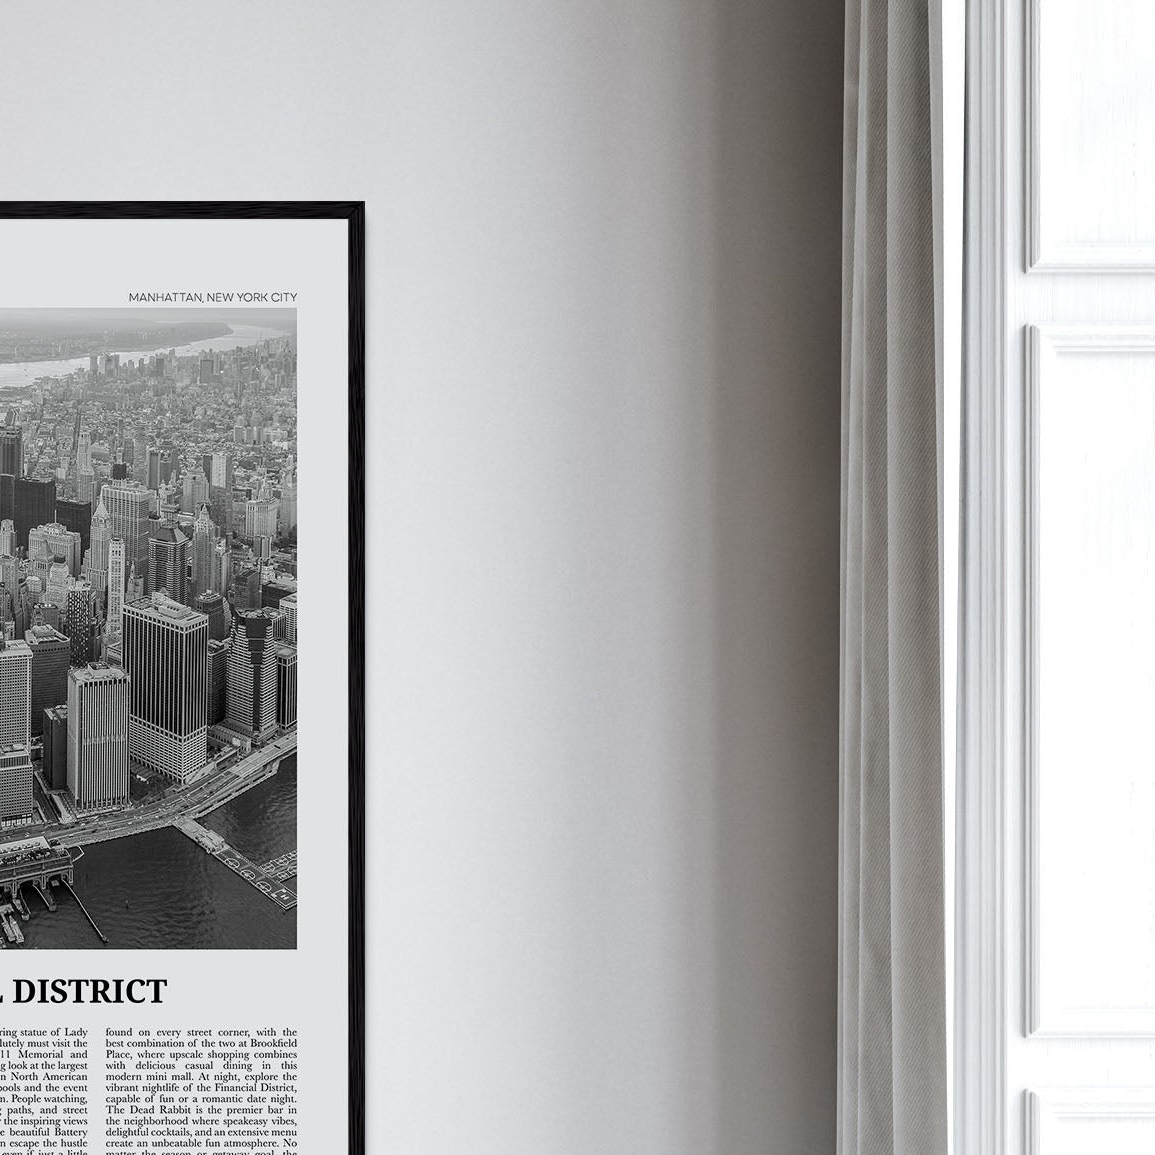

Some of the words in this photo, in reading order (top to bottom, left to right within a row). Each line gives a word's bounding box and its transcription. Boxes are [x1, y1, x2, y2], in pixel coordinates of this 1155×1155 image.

[129, 292, 204, 303] MANHATTAN,
[207, 292, 234, 302] NEW
[237, 292, 268, 302] YORK
[271, 292, 297, 302] CITY
[12, 979, 168, 1004] DISTRICT
[106, 1028, 133, 1036] found
[156, 1030, 182, 1039] every
[218, 1030, 250, 1038] corner,
[256, 1028, 277, 1036] with
[282, 1028, 297, 1036] the
[52, 1039, 71, 1047] visit
[73, 1039, 88, 1047] the
[1, 1050, 10, 1058] 11
[18, 1050, 63, 1058] Memorial
[70, 1050, 88, 1058] and
[106, 1050, 133, 1060] Place,
[137, 1050, 165, 1058] where
[169, 1050, 203, 1061] upscale
[207, 1050, 250, 1061] shopping
[253, 1050, 298, 1058] combines
[105, 1061, 126, 1069] with
[135, 1061, 176, 1069] delicious
[185, 1061, 213, 1069] casual
[222, 1061, 253, 1072] dining
[262, 1061, 271, 1069] in
[281, 1061, 298, 1069] this
[11, 1072, 38, 1081] North
[42, 1072, 88, 1081] American
[105, 1083, 139, 1092] vibrant
[142, 1083, 180, 1094] nightlife
[182, 1083, 193, 1092] of
[196, 1083, 211, 1092] the
[215, 1083, 257, 1092] Financial
[261, 1083, 297, 1093] District,
[7, 1105, 34, 1116] paths,
[39, 1105, 58, 1114] and
[3, 1117, 18, 1125] the
[20, 1117, 61, 1127] inspiring
[62, 1117, 88, 1125] views
[106, 1117, 121, 1125] the
[124, 1117, 188, 1127] neighborhood
[191, 1117, 220, 1125] where
[223, 1117, 268, 1127] speakeasy
[271, 1117, 297, 1126] vibes,
[9, 1128, 50, 1136] beautiful
[55, 1128, 88, 1138] Battery
[105, 1128, 149, 1138] delightful
[150, 1128, 193, 1137] cocktails,
[194, 1128, 212, 1136] and
[227, 1128, 269, 1136] extensive
[9, 1141, 40, 1150] escape
[43, 1139, 57, 1147] the
[60, 1139, 88, 1147] hustle
[151, 1139, 202, 1147] unbeatable
[205, 1139, 221, 1147] fun
[223, 1139, 279, 1150] atmosphere.
[283, 1139, 298, 1147] No
